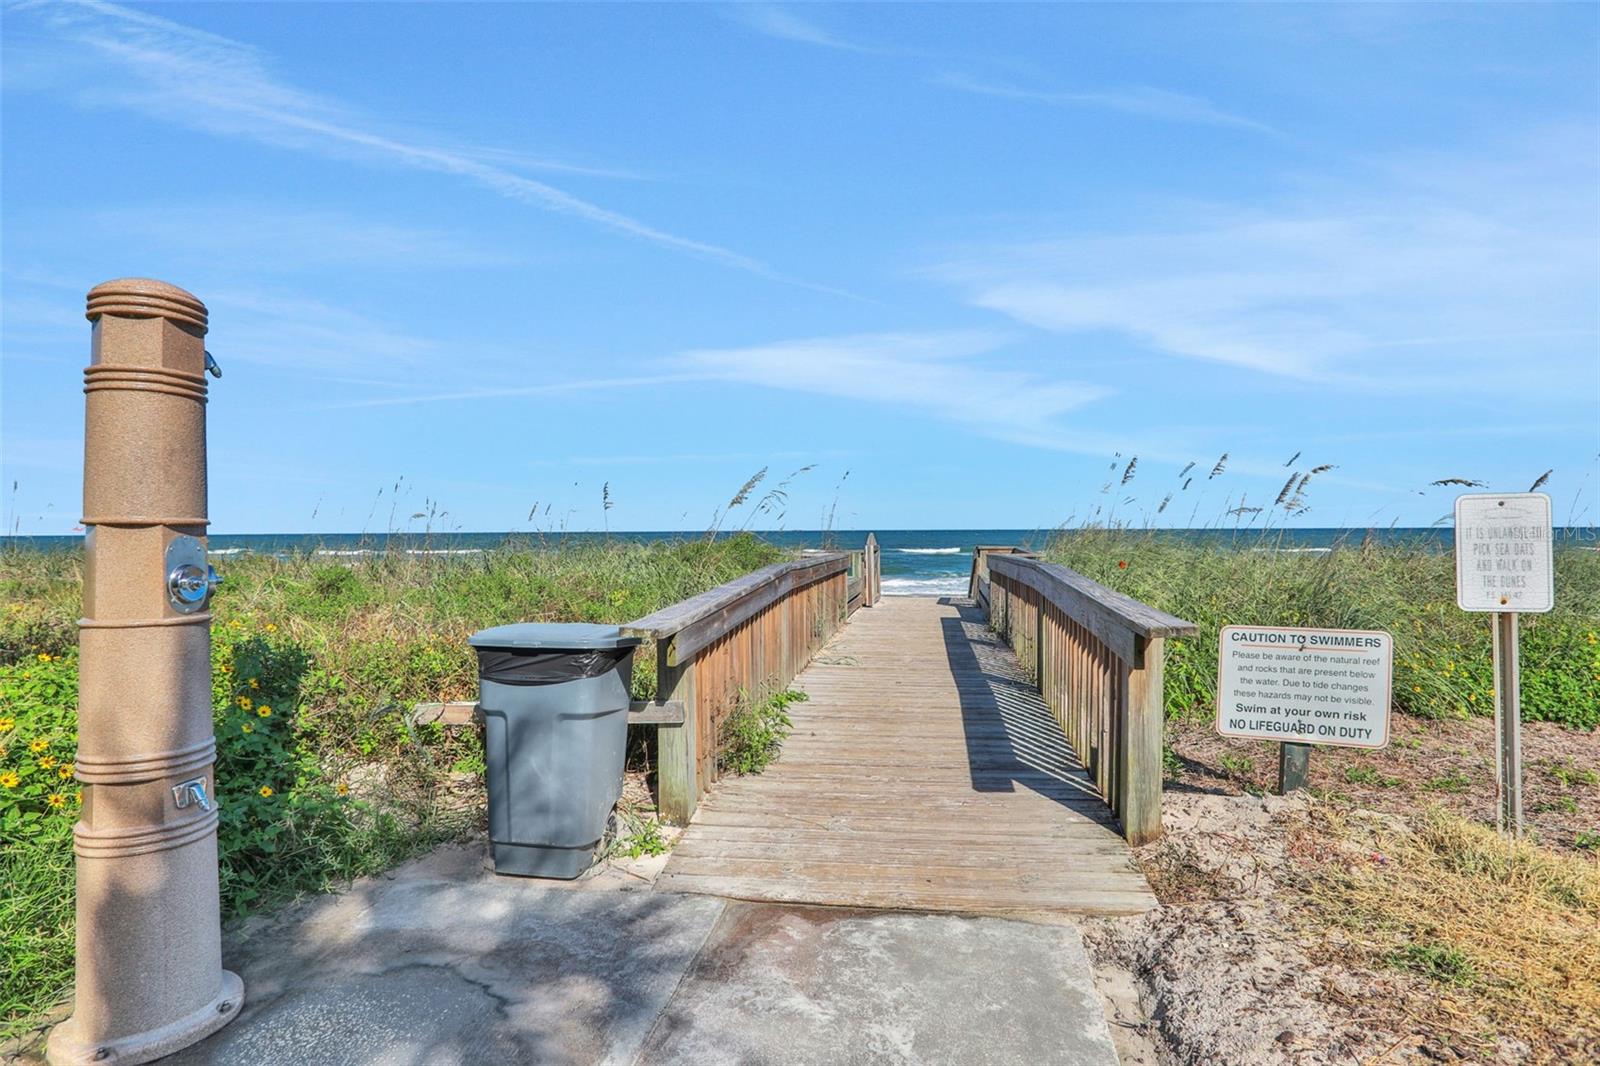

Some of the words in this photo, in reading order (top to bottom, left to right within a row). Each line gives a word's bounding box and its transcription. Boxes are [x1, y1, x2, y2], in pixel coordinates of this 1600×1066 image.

[1473, 543, 1491, 556] PICK
[1495, 543, 1510, 556] SEA
[1514, 543, 1535, 556] OATS
[1476, 559, 1492, 571] AND
[1497, 559, 1517, 571] WALK
[1522, 559, 1532, 571] ON
[1483, 576, 1496, 587] THE
[1500, 576, 1526, 588] DUNES
[1232, 632, 1286, 644] CAUTION
[1290, 635, 1306, 644] TO
[1310, 636, 1381, 648] SWIMMERS
[1232, 651, 1260, 660] Please
[1263, 653, 1273, 661] be
[1303, 654, 1312, 662] of
[1314, 655, 1327, 663] the
[1330, 656, 1360, 665] natural
[1238, 664, 1253, 672] and
[1256, 665, 1278, 673] rocks
[1280, 666, 1296, 674] that
[1314, 669, 1347, 678] present
[1350, 670, 1376, 679] below
[1240, 677, 1253, 685] the
[1256, 678, 1280, 686] water.
[1283, 679, 1300, 687] Due
[1302, 680, 1310, 688] to
[1313, 680, 1329, 689] tide
[1331, 682, 1368, 692] changes
[1234, 689, 1256, 697] these
[1259, 690, 1291, 700] hazards
[1294, 694, 1312, 703] may
[1314, 694, 1328, 702] not
[1331, 695, 1342, 703] be
[1344, 696, 1375, 706] visible.
[1236, 704, 1267, 714] Swim
[1270, 706, 1281, 715] at
[1285, 709, 1312, 718] your
[1315, 711, 1339, 719] own
[1344, 711, 1367, 721] risk
[1230, 719, 1246, 729] NO
[1249, 720, 1315, 735] LIFEGUARD
[1319, 726, 1336, 736] ON
[1340, 727, 1372, 739] DUTY
